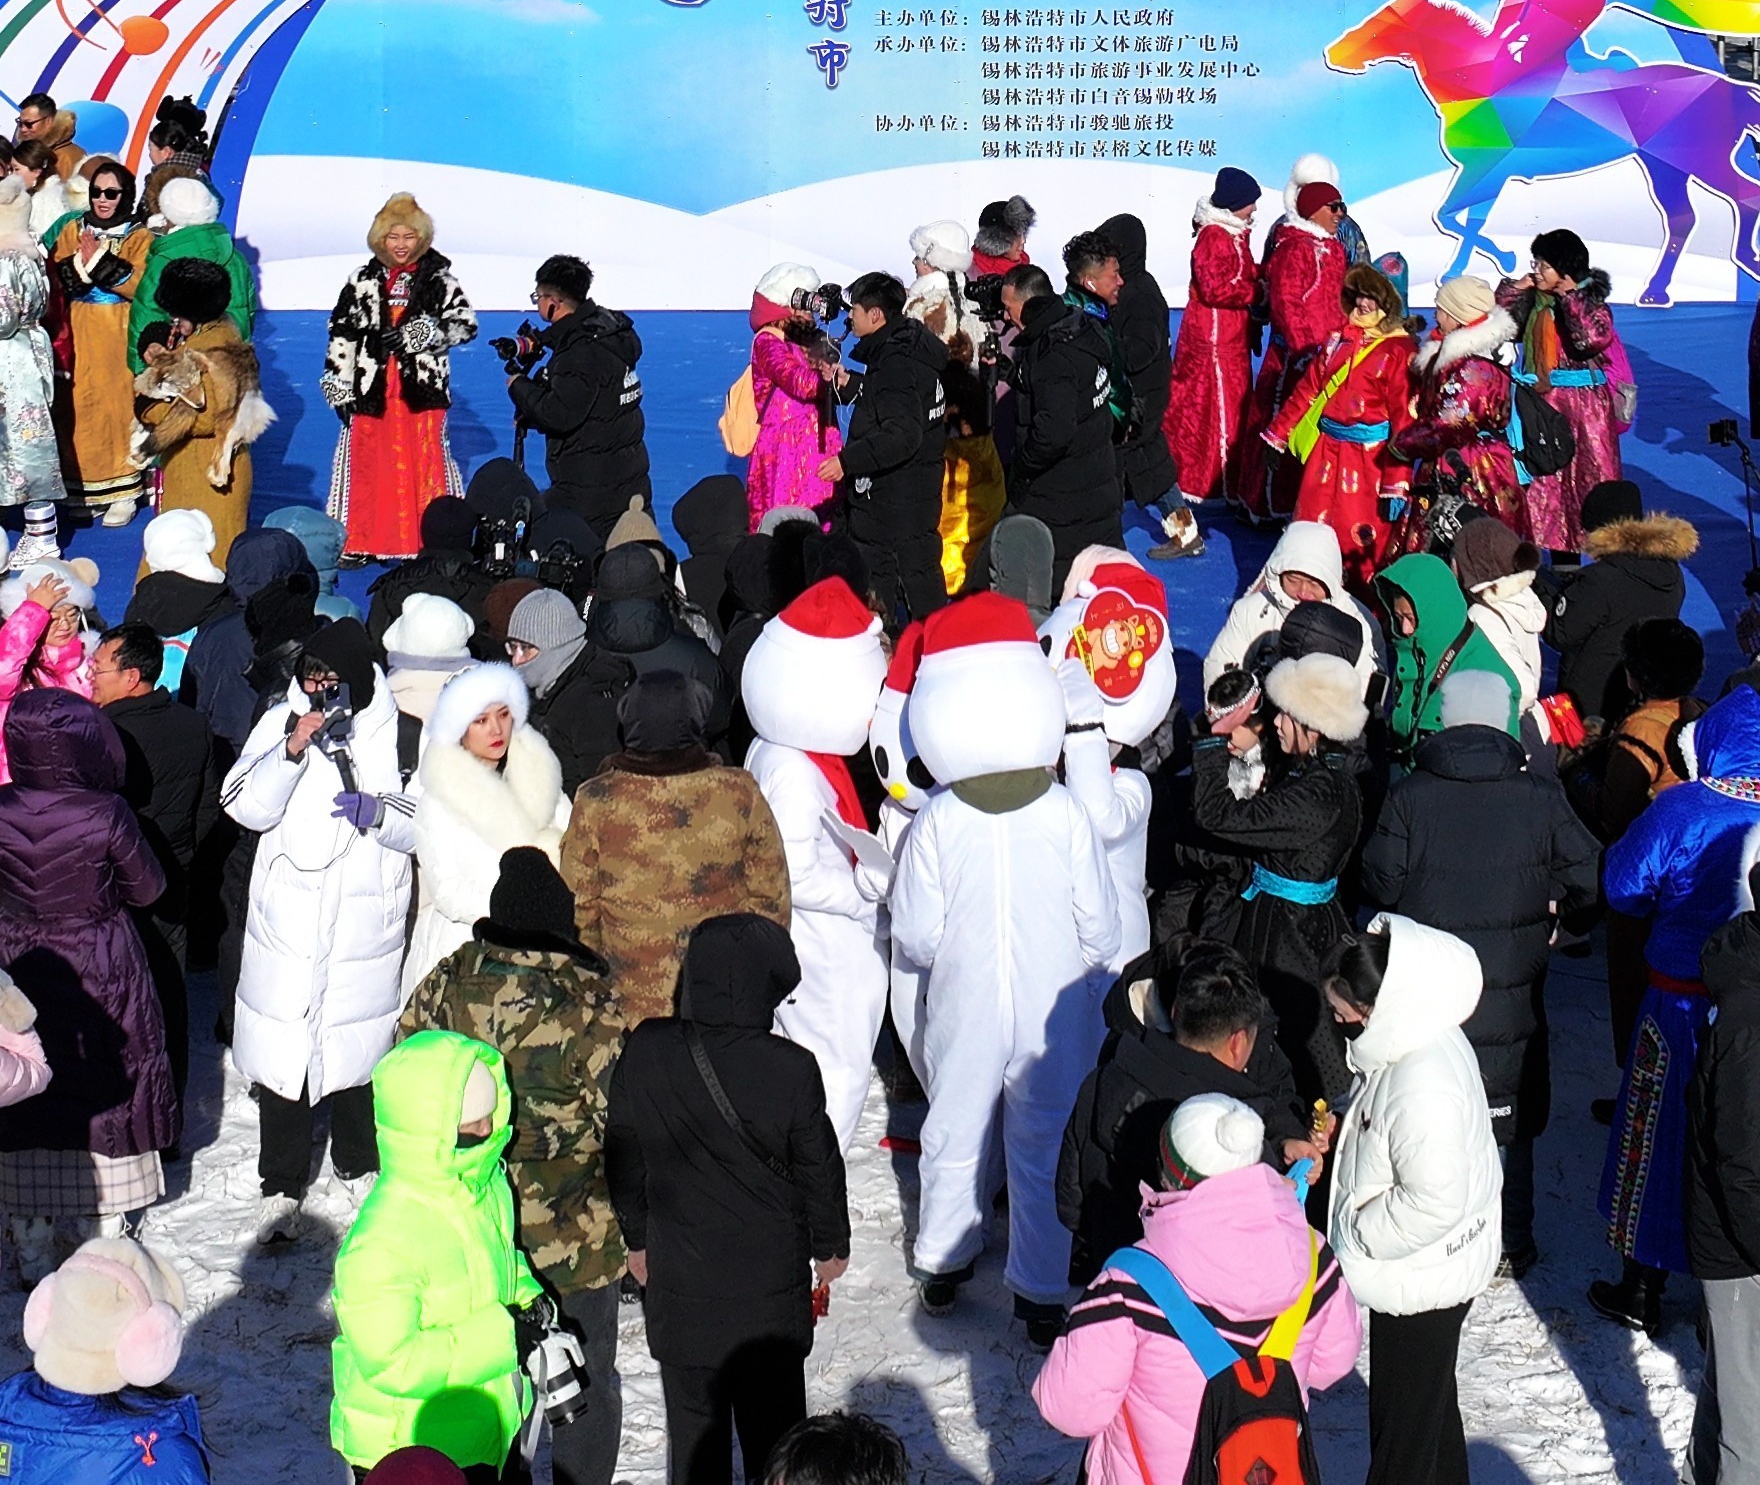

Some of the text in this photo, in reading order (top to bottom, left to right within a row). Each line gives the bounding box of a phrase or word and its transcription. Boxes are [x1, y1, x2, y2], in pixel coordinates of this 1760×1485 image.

[981, 8, 1175, 27] 锡林浩特市人民政府
[981, 34, 1239, 54] 锡林浩特市文体旅游广电局
[981, 60, 1261, 80] 锡林浩特市旅游事业发展中心
[981, 86, 1218, 106] 锡林浩特市白音锡勒牧场
[981, 113, 1175, 132] 锡林浩特市骏驰旅投
[981, 139, 1218, 159] 锡林浩特市喜榕文化传媒
